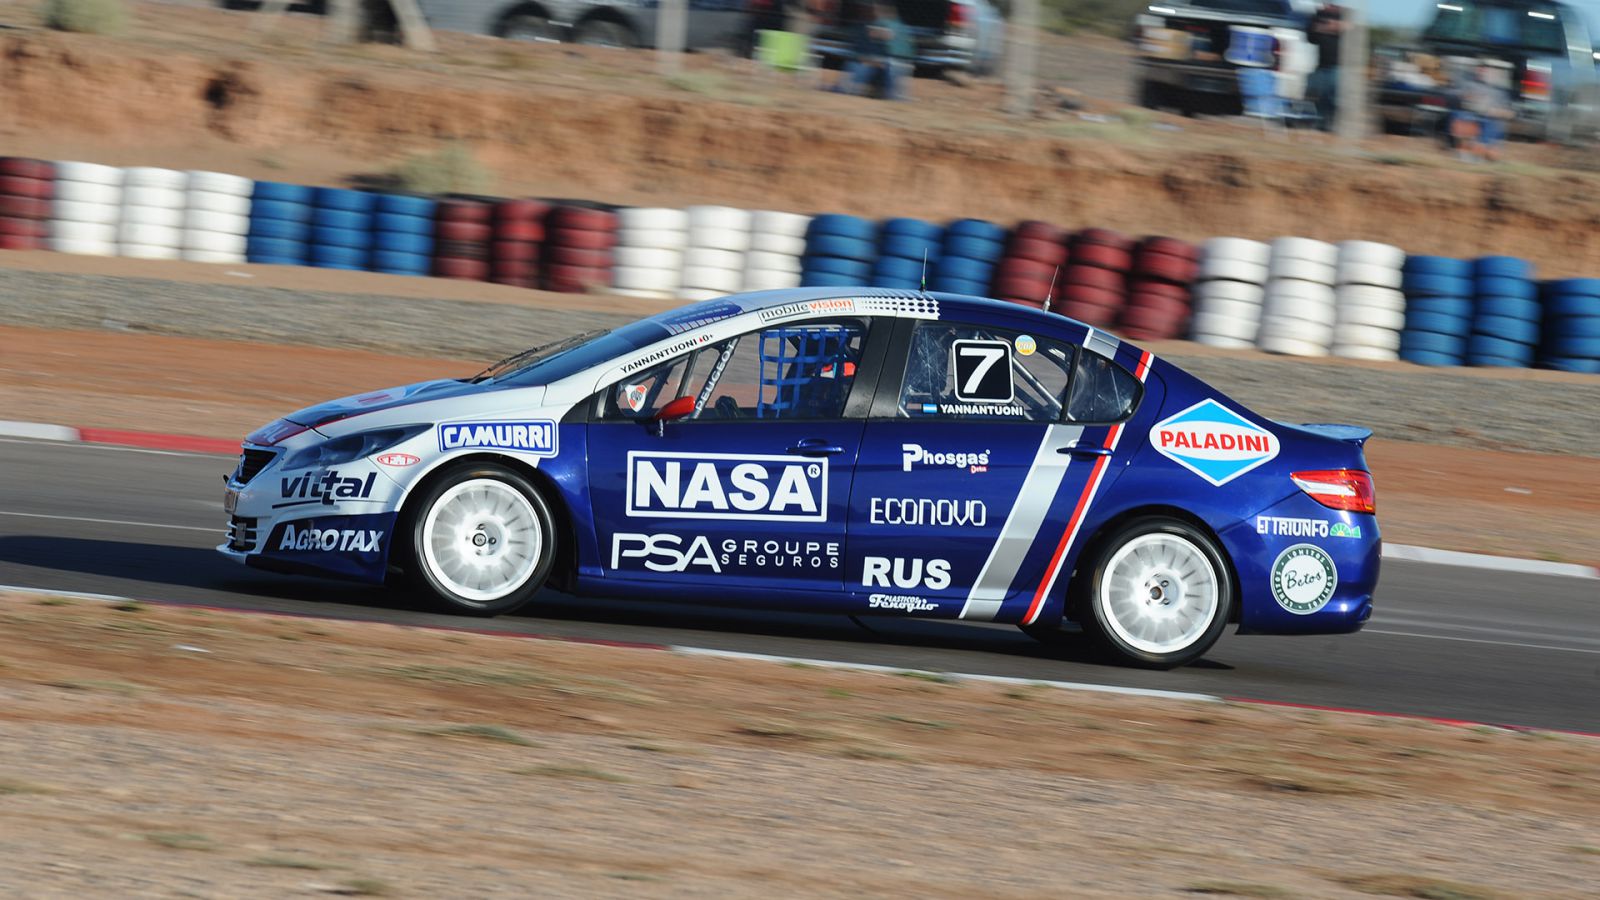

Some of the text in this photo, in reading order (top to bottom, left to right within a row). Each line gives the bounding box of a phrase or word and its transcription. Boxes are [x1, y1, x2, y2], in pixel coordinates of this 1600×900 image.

[761, 299, 852, 319] mobilevision
[620, 338, 698, 374] YANNANTUONI
[959, 347, 1005, 394] 7
[695, 340, 735, 411] PEUGEOT
[940, 404, 1024, 416] YANNANTUONI
[443, 424, 551, 449] CAMURRI
[1159, 430, 1270, 453] PALADINI
[902, 443, 989, 472] Phosgas
[635, 460, 818, 512] NASA
[869, 497, 987, 527] ECONOVO
[279, 523, 385, 553] AGROTAX
[610, 532, 840, 574] PSA GROUPE
[720, 554, 839, 568] SEGUROS
[861, 555, 952, 590] RUS
[1284, 569, 1322, 590] Betos
